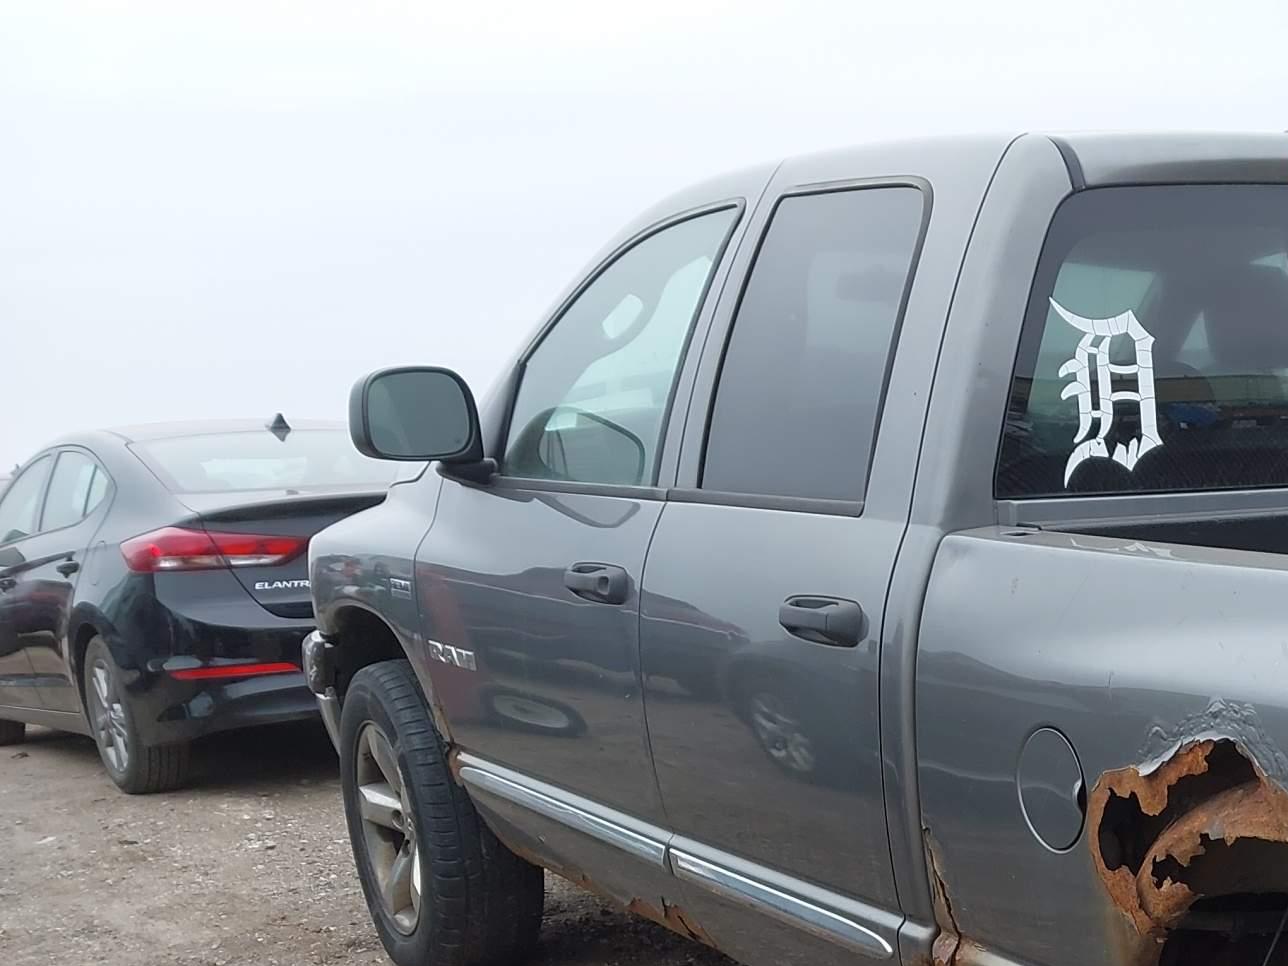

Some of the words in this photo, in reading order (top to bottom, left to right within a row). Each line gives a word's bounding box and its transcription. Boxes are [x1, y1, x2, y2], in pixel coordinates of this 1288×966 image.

[1049, 296, 1164, 489] D
[255, 580, 311, 590] ELANTR
[428, 640, 477, 671] RAM
